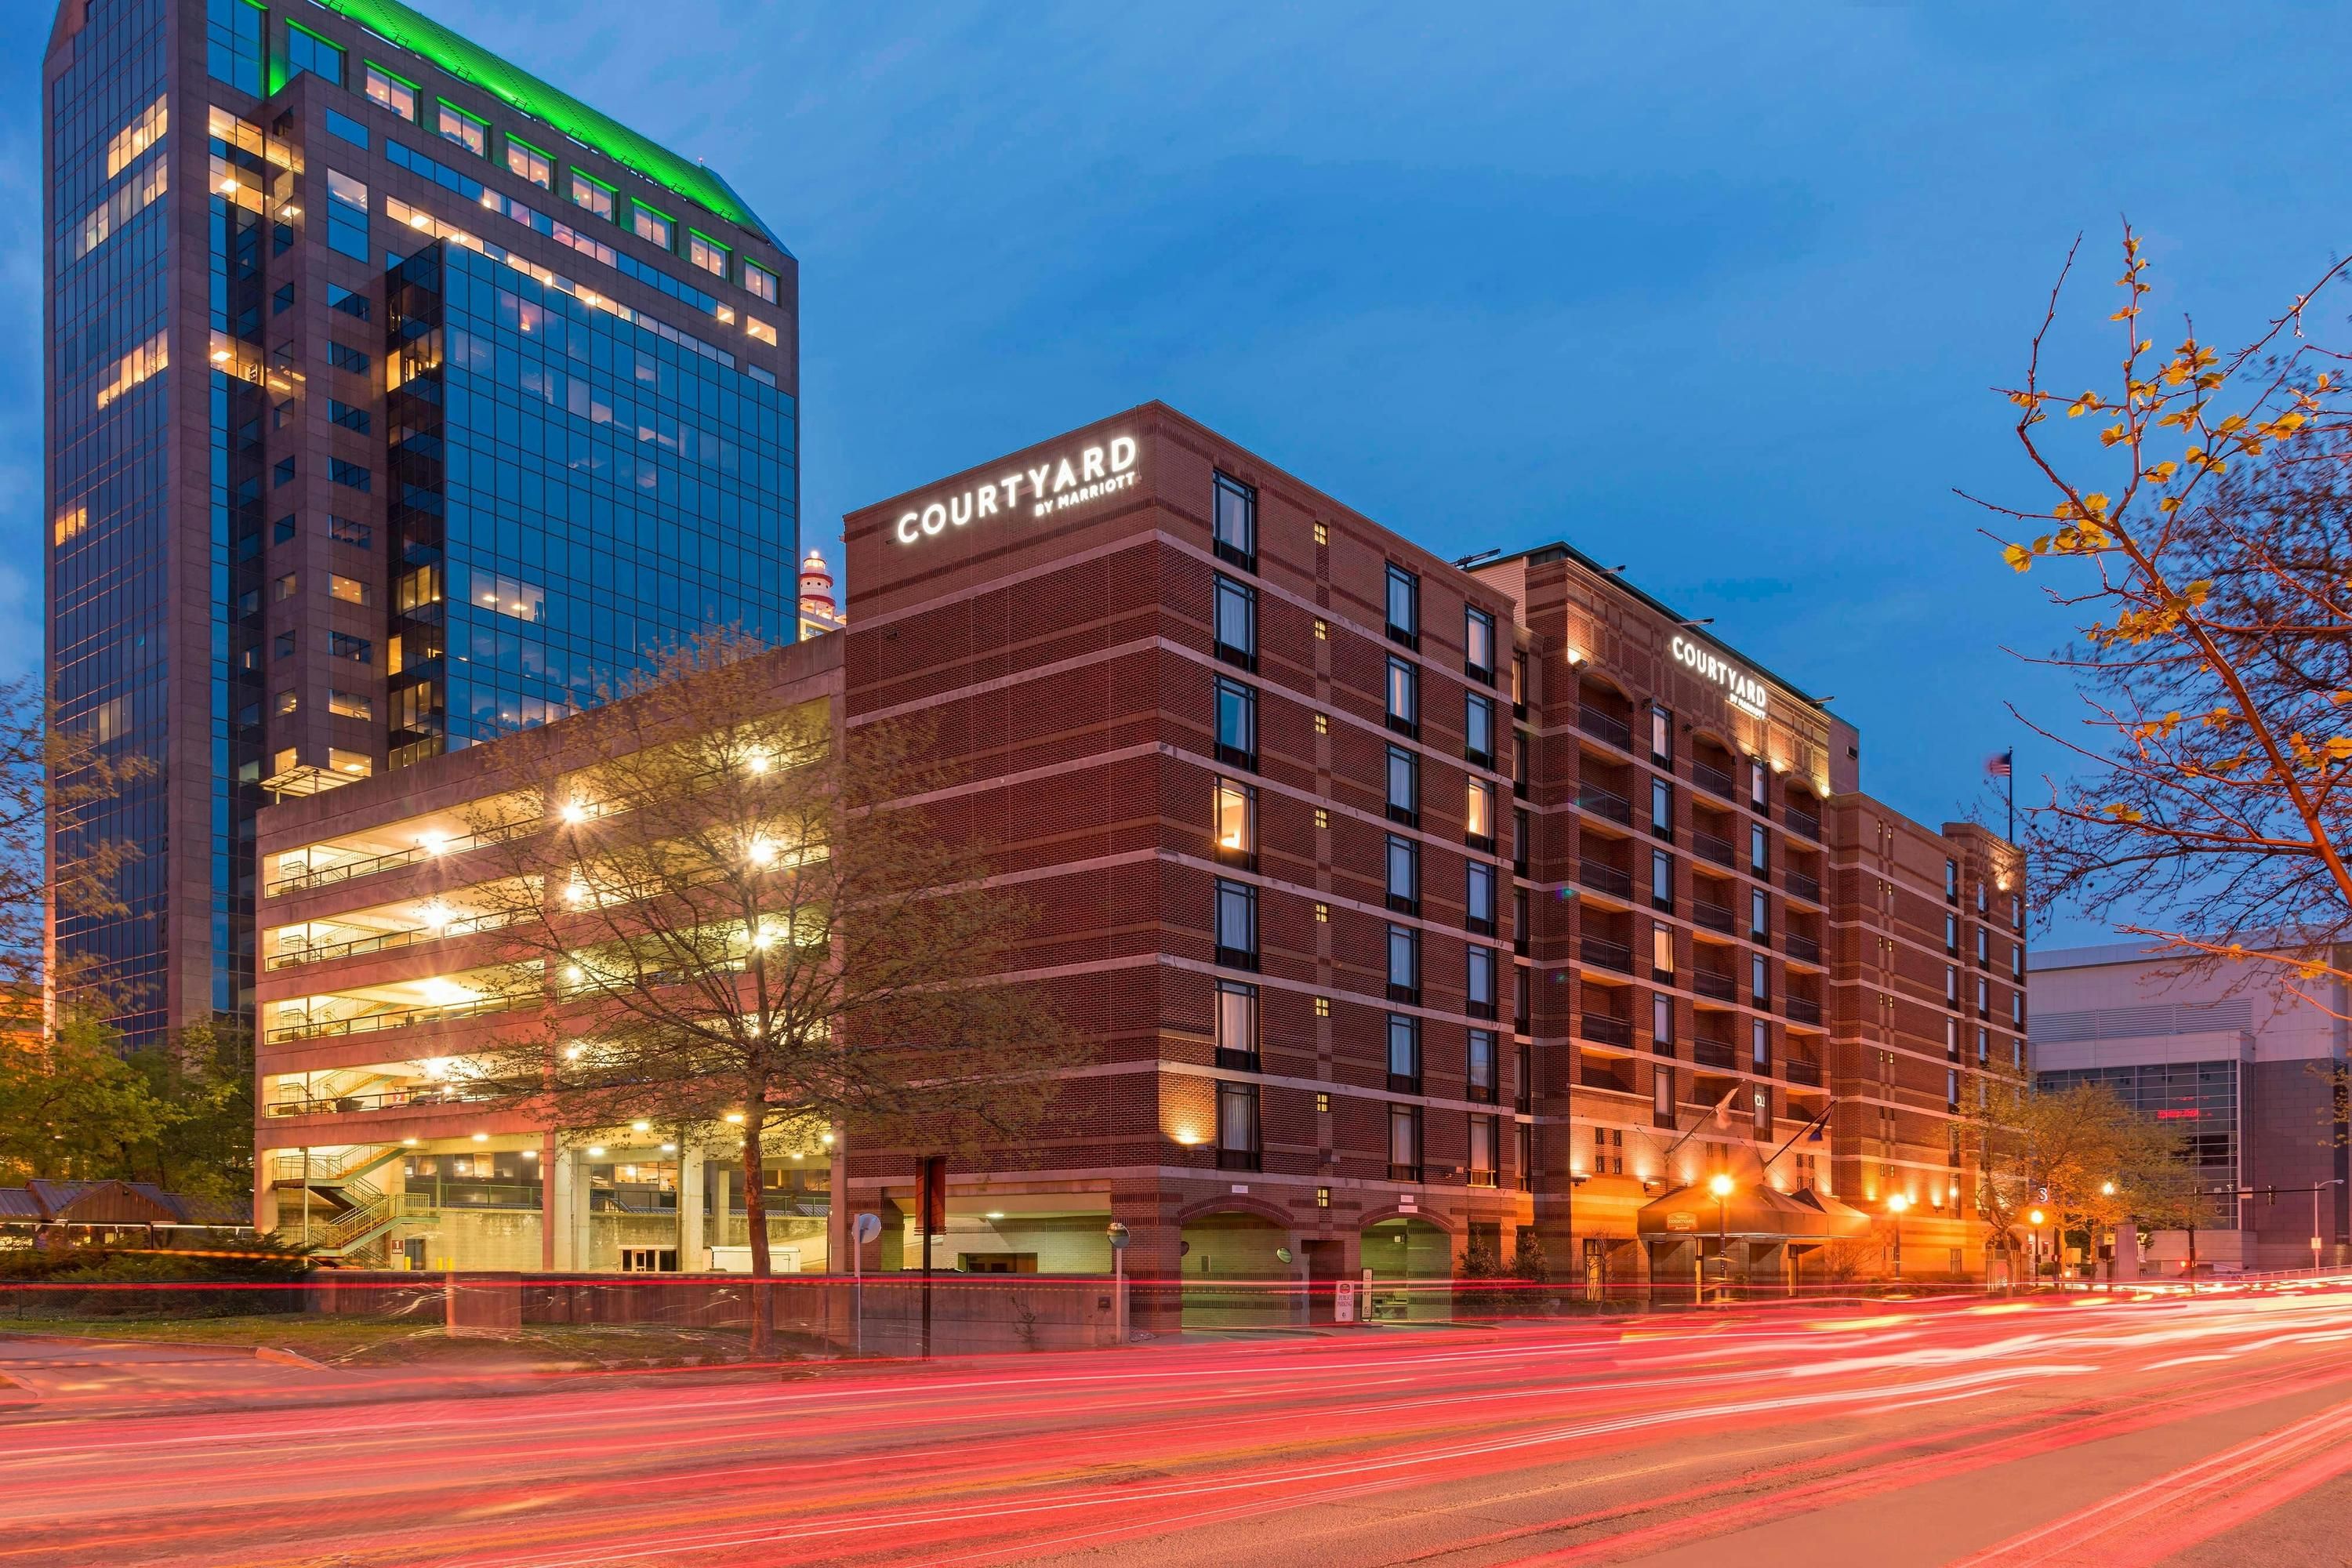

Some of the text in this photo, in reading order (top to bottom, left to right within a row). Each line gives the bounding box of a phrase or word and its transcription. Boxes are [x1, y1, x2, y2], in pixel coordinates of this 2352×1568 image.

[897, 437, 1137, 543] COURTYARD
[1035, 472, 1136, 517] BY MARRIOTT
[1672, 637, 1766, 708] COURTYARD
[395, 1094, 401, 1102] 2
